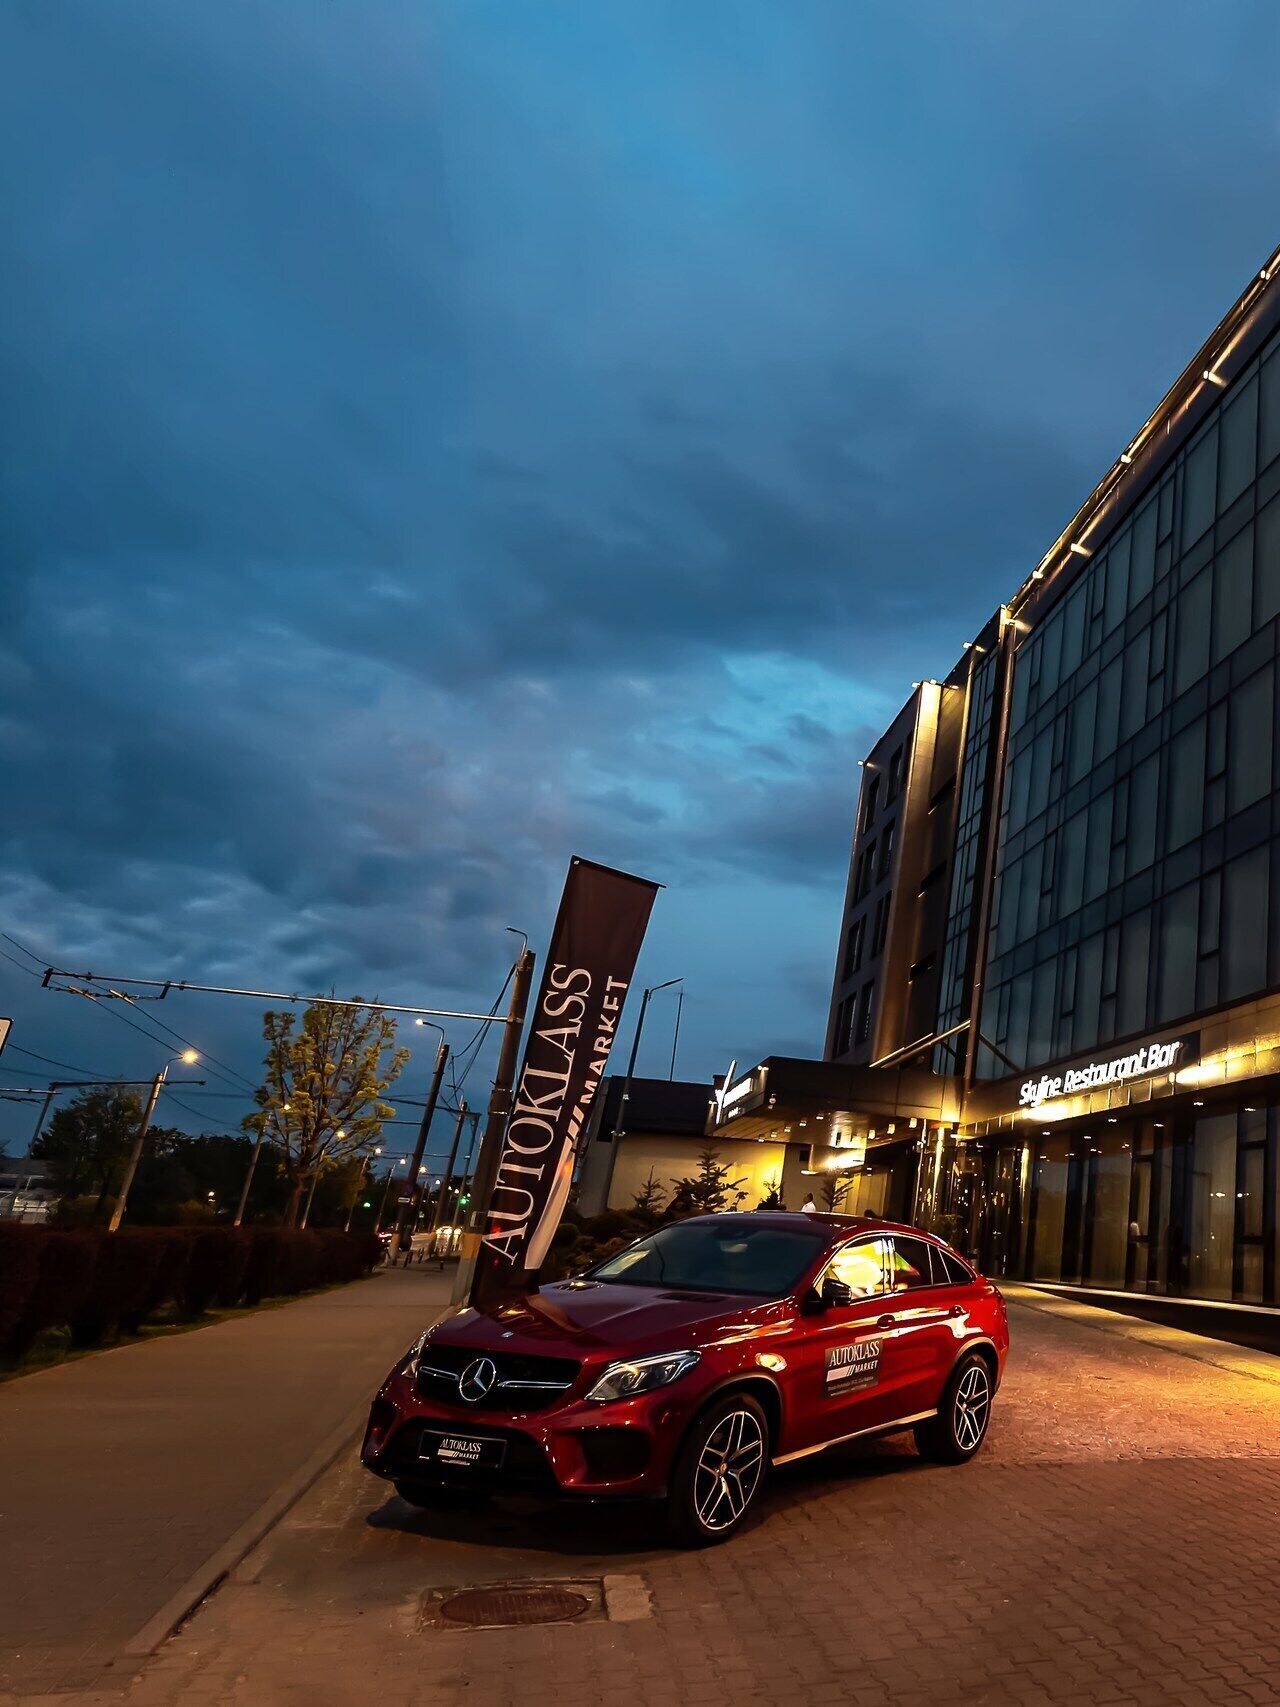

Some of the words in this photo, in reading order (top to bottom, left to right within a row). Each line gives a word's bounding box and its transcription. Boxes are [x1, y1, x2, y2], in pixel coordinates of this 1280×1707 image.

[580, 975, 628, 1105] MARKET
[1019, 1075, 1063, 1107] Skyline
[1063, 1047, 1147, 1094] Restaurant
[1146, 1041, 1181, 1071] Bar
[481, 963, 592, 1266] AUTOKLASS
[828, 1340, 880, 1367] AUTOKLASS
[854, 1360, 879, 1373] MARKET
[440, 1438, 482, 1453] AUTOKLASS
